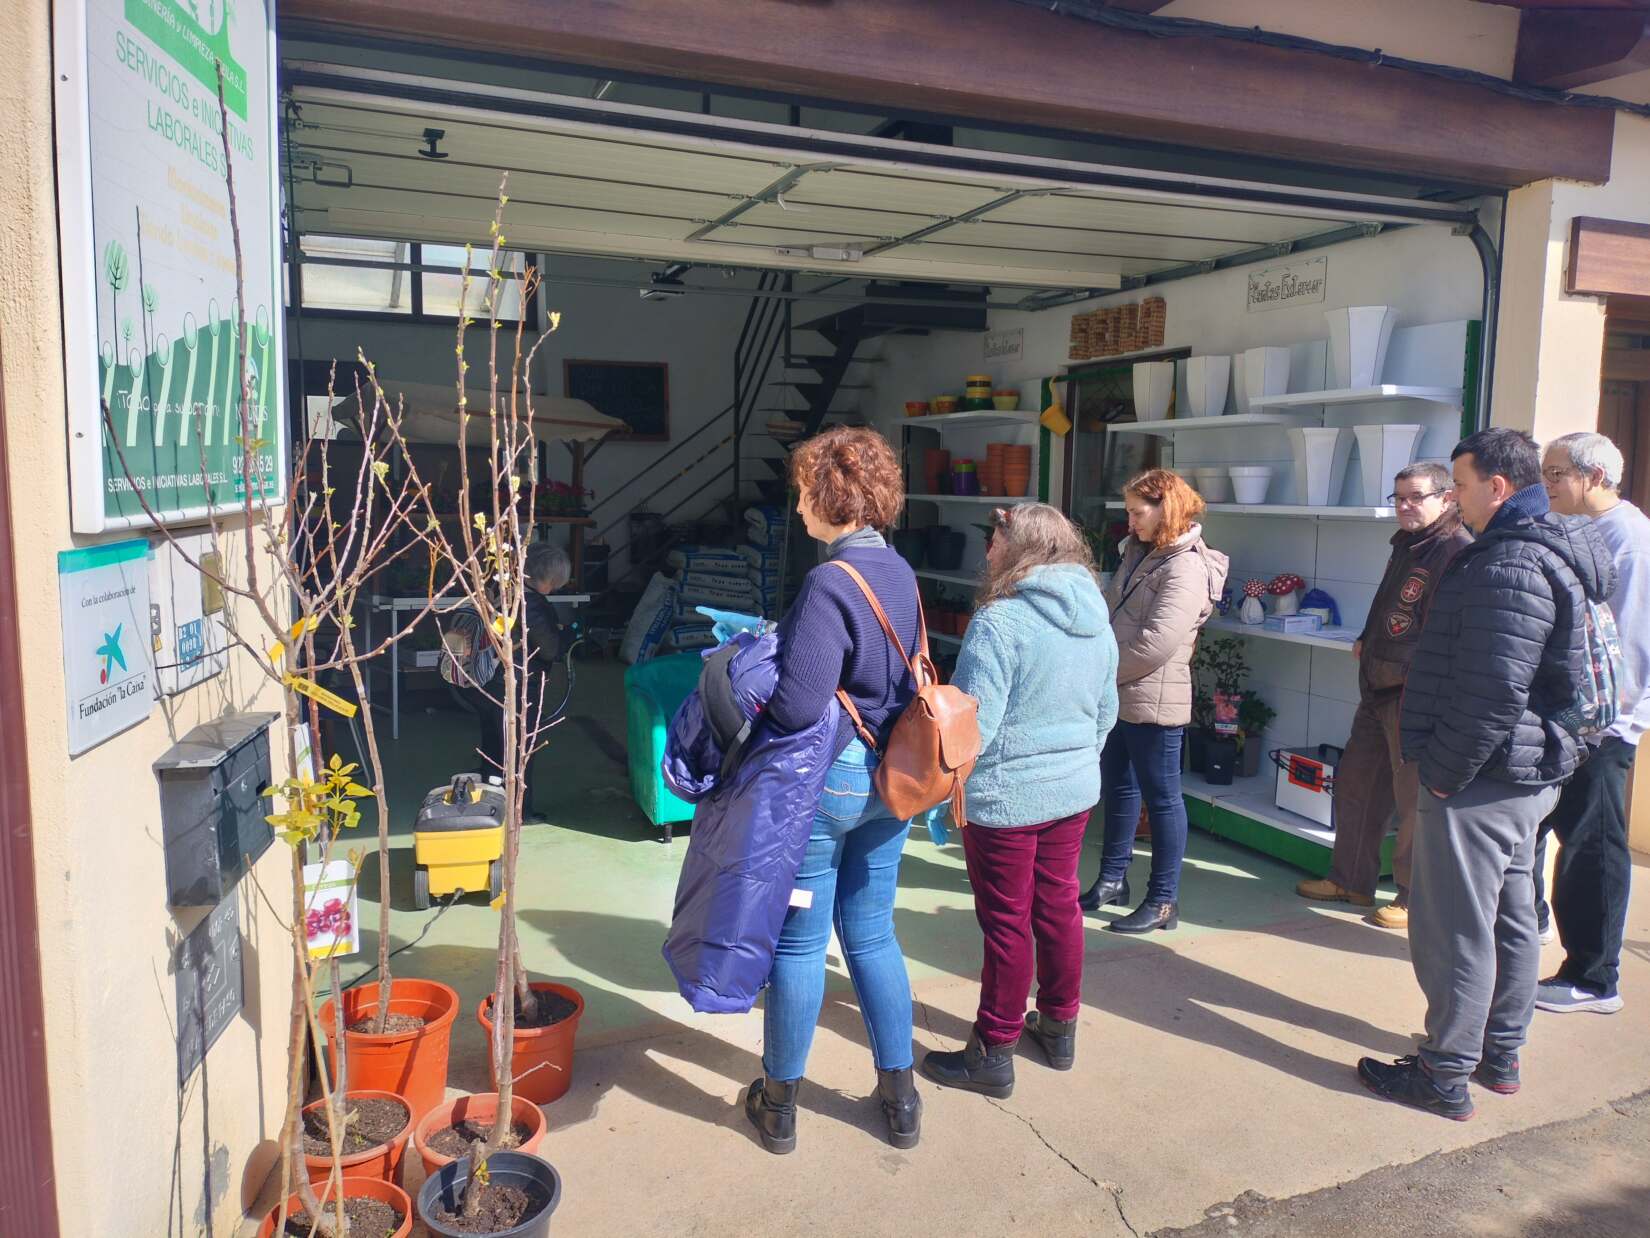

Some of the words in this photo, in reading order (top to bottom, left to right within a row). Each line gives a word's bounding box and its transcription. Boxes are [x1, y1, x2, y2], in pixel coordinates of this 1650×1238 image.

[182, 25, 214, 65] LIMPIEZA
[115, 30, 190, 111] SERVICIOS
[192, 98, 199, 117] e
[201, 99, 254, 161] INICTIVAS
[147, 100, 218, 172] LABORALES
[265, 455, 273, 472] 29
[107, 476, 146, 493] SERVICIOS
[147, 479, 152, 489] e
[152, 474, 188, 489] INICIATIVAS
[188, 470, 219, 487] LABOALES
[81, 595, 93, 608] Con
[92, 595, 99, 605] la
[99, 588, 130, 603] colaboración
[130, 586, 136, 596] de
[79, 691, 117, 720] Fundación
